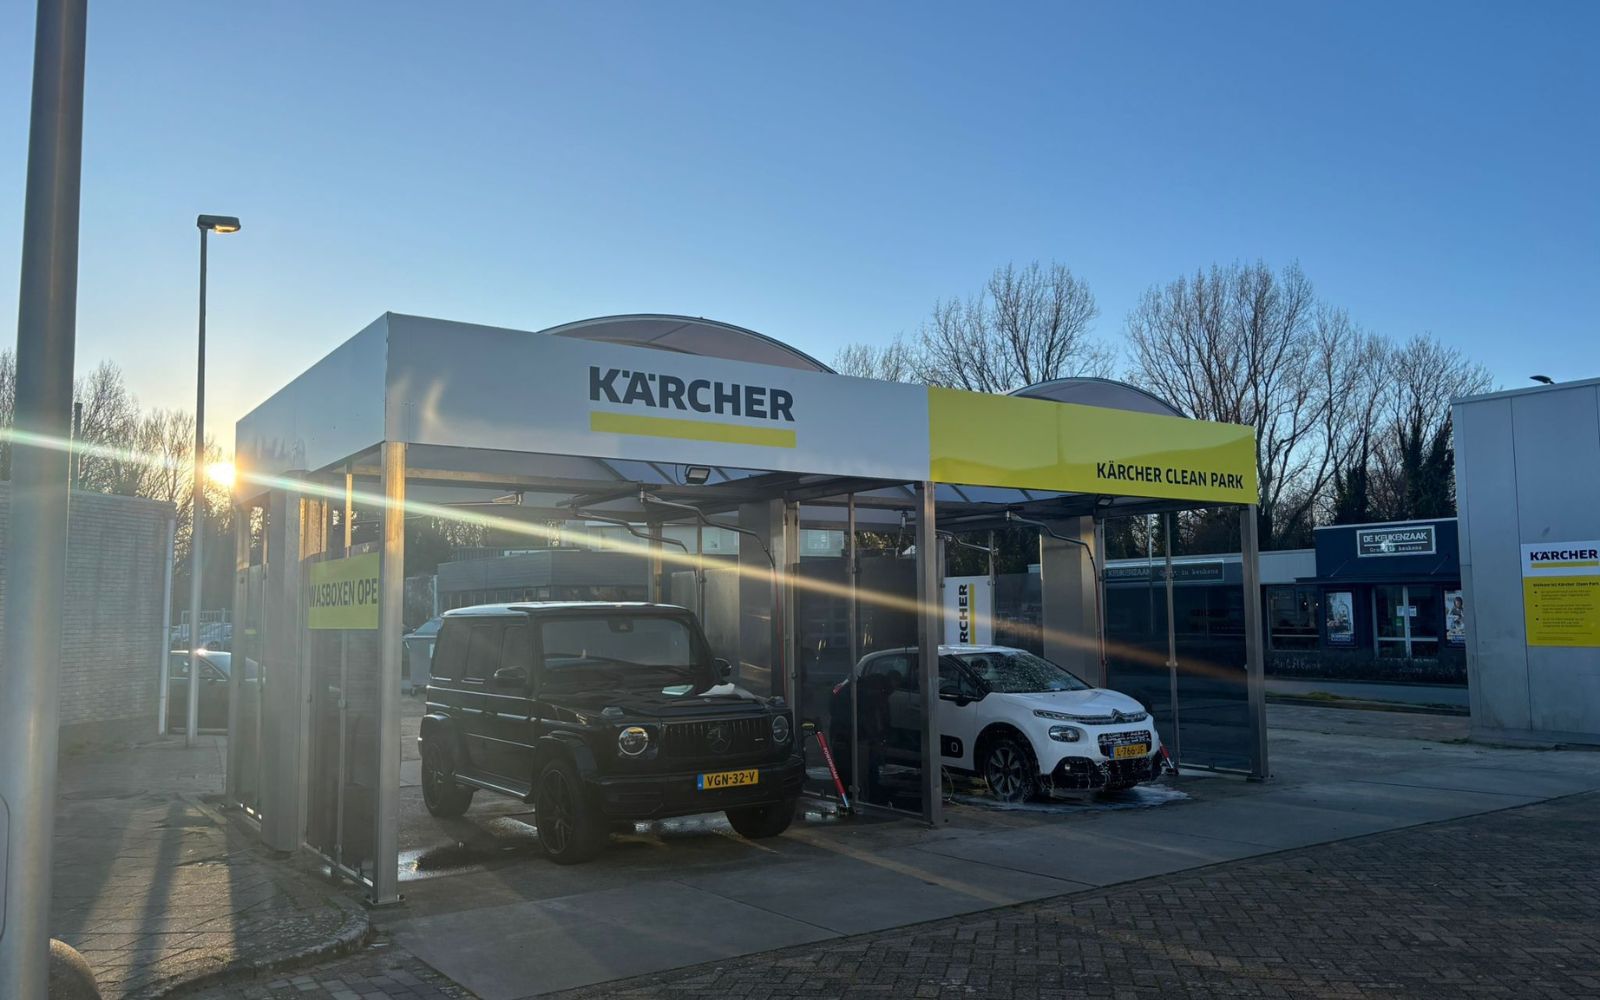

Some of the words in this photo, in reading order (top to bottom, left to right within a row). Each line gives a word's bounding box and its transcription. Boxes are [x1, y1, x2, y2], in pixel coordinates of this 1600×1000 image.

[589, 366, 795, 422] KÄRCHER
[1097, 460, 1162, 483] KÄRCHER
[1165, 468, 1207, 487] CLEAN
[1210, 472, 1244, 489] PARK
[1363, 535, 1374, 543] DE
[1374, 532, 1428, 542] KEUKENZAAK
[1530, 549, 1598, 561] KÄRCHER
[309, 580, 355, 608] WASBOXEN
[357, 578, 378, 605] OPE
[959, 584, 968, 643] RCHER
[707, 771, 755, 787] VGN-32-V
